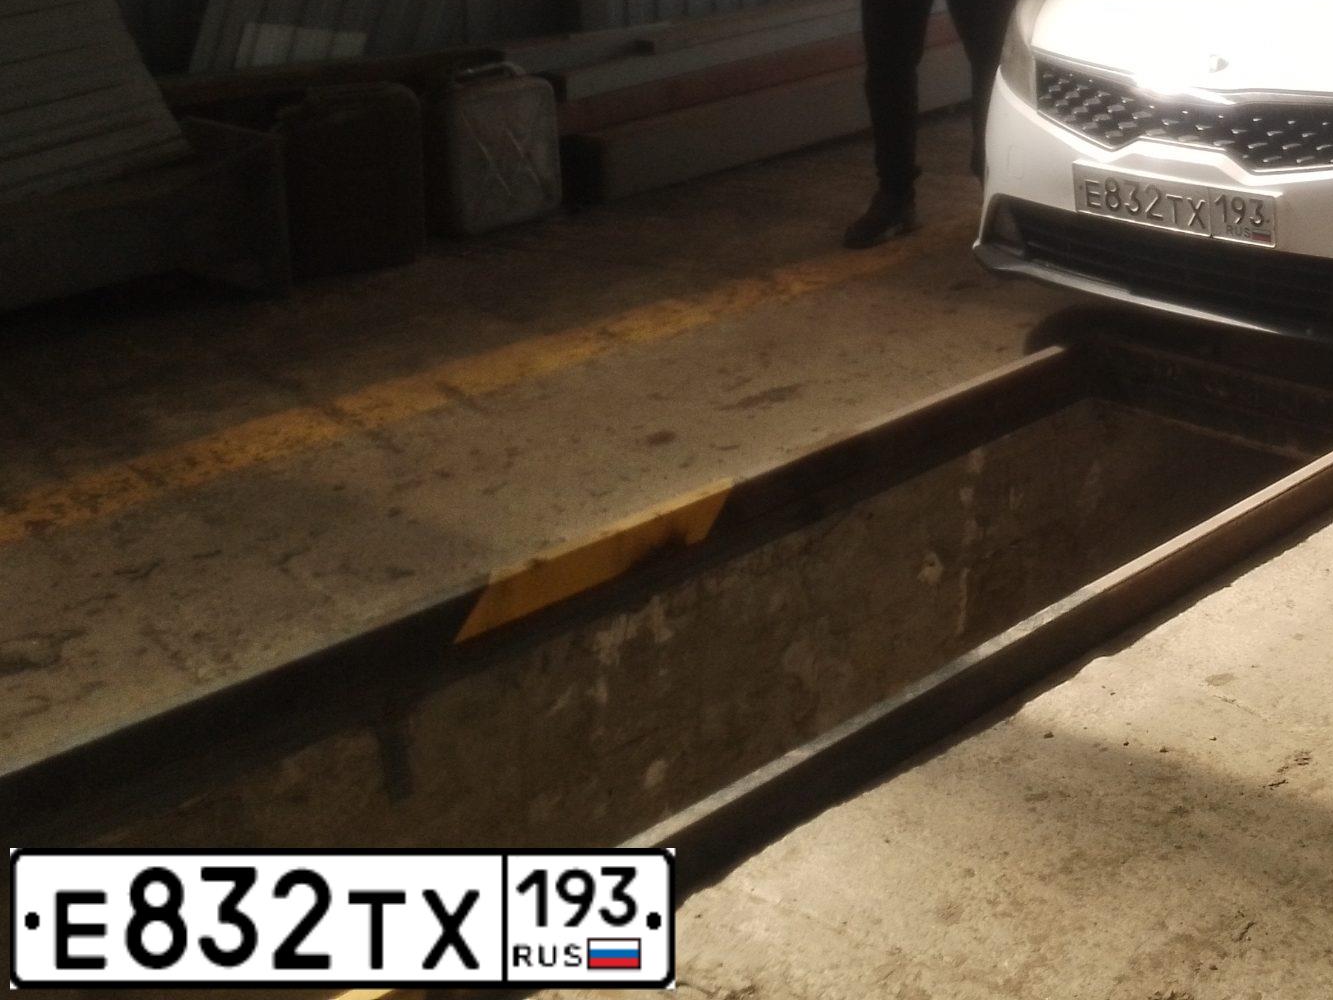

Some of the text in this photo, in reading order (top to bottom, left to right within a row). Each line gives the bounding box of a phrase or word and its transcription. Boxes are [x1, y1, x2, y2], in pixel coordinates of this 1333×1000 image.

[1085, 177, 1264, 229] E832TX 193
[1226, 224, 1250, 238] RUS
